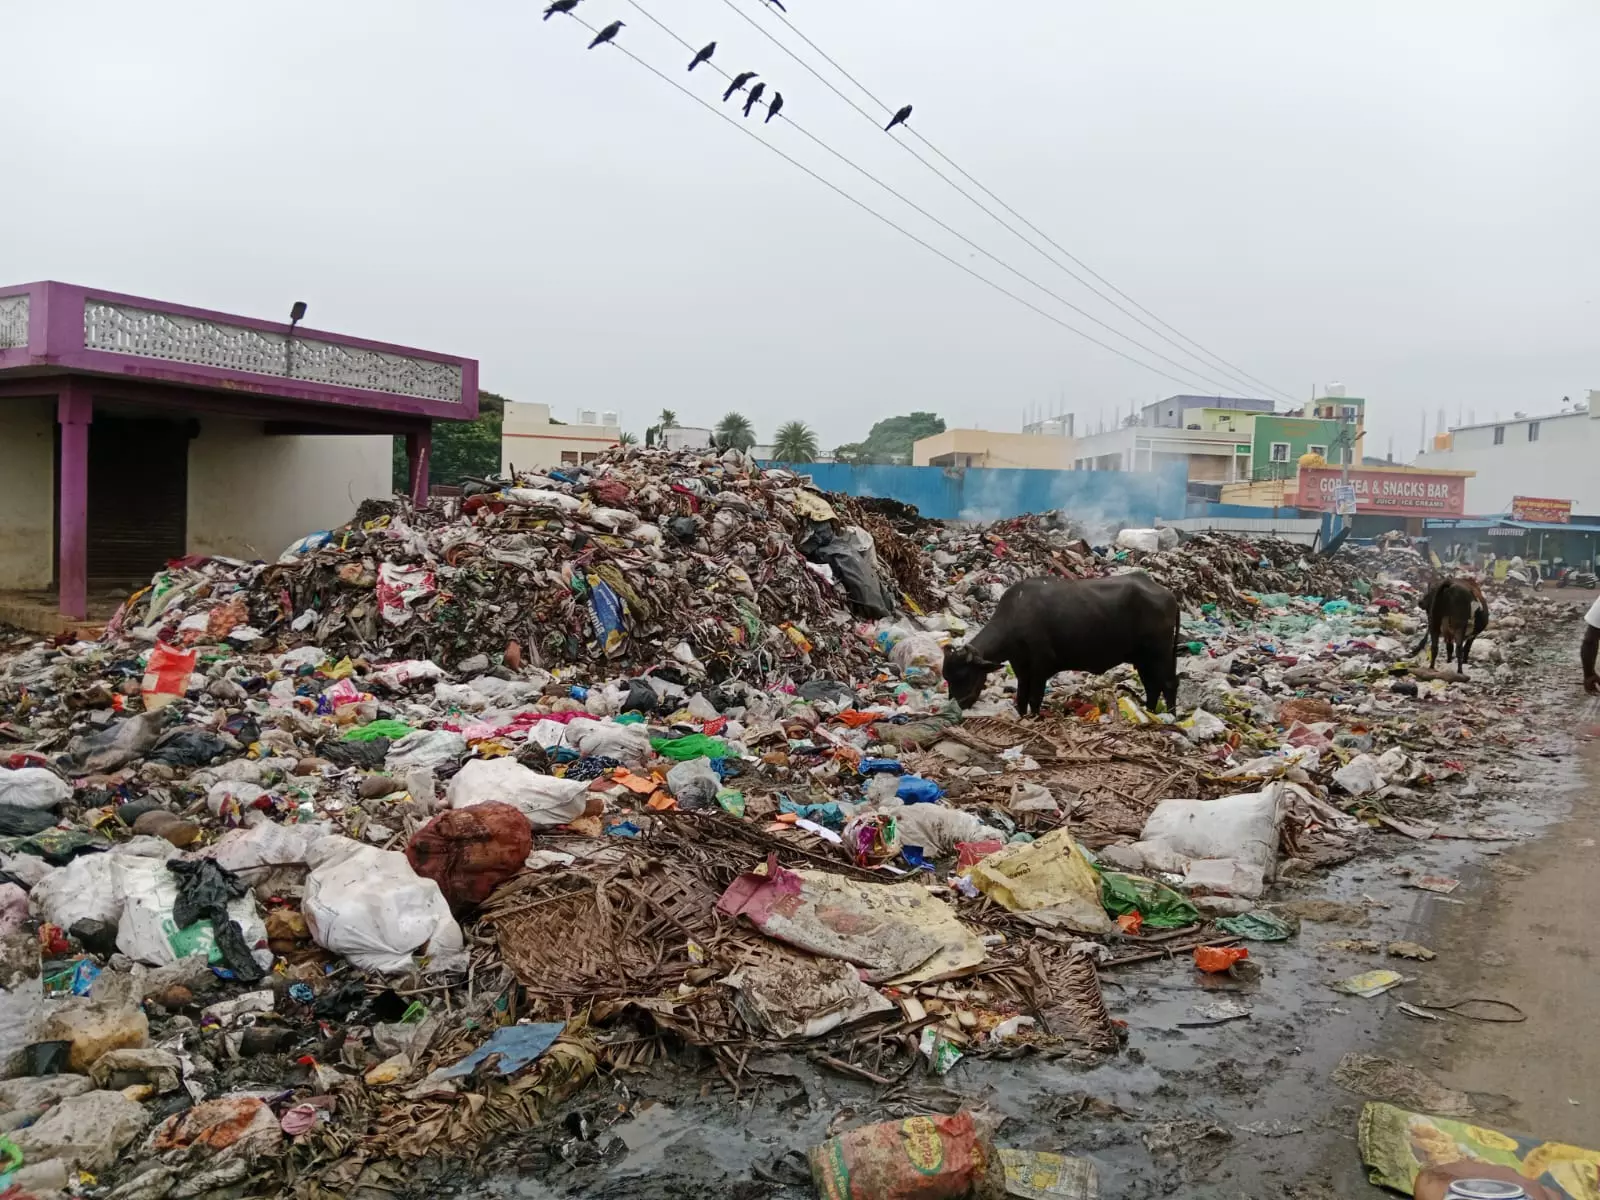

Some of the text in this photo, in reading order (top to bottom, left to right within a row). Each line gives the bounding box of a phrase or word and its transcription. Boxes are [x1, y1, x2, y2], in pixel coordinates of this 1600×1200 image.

[1371, 480, 1380, 494] &
[1382, 481, 1425, 497] SNACKS
[1427, 483, 1449, 498] BAR
